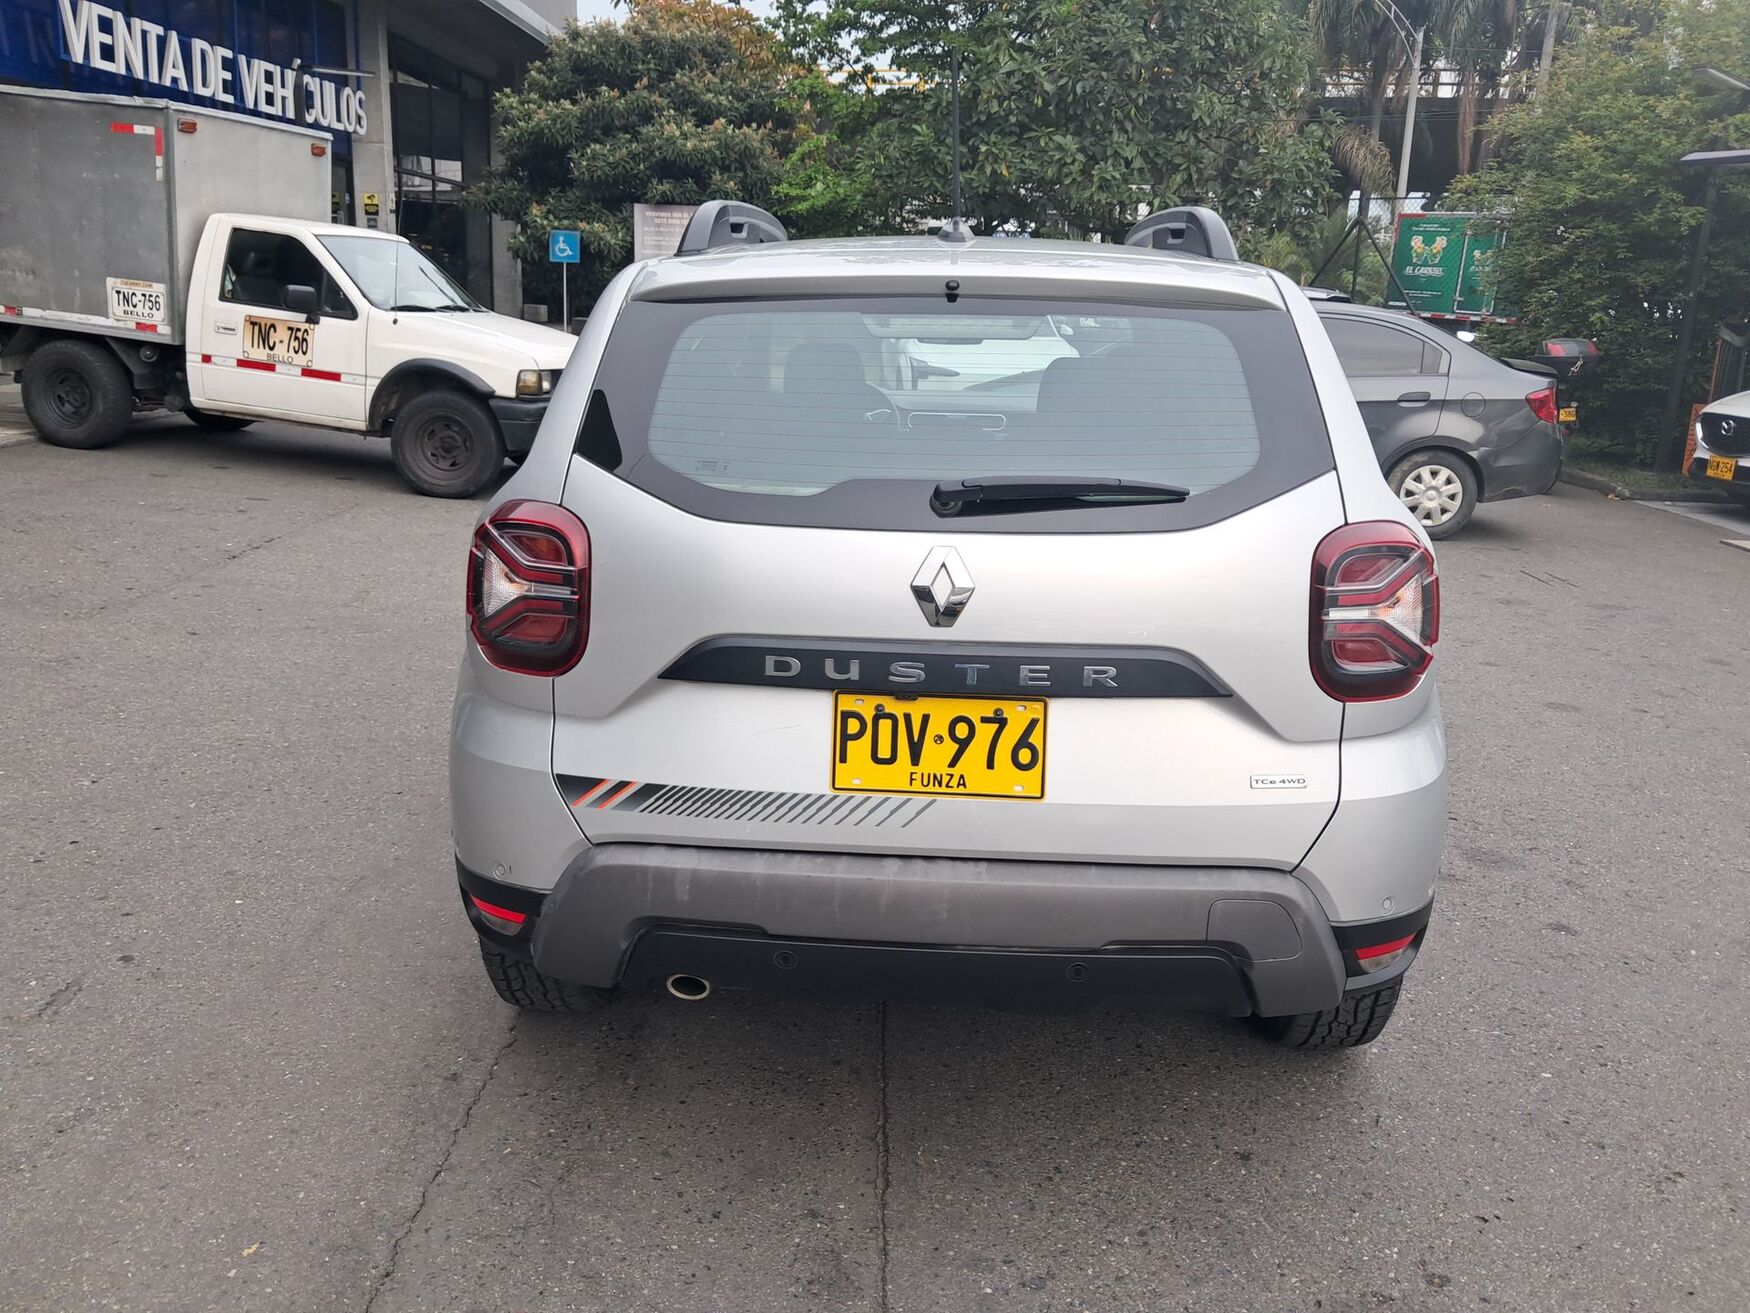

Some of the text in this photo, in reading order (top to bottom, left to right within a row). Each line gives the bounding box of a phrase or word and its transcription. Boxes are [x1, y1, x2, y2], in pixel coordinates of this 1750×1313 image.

[59, 0, 188, 92] VENTA
[192, 38, 236, 104] DE
[115, 289, 161, 312] TNC-756
[123, 309, 154, 319] BELLO
[266, 352, 294, 364] BELLO
[764, 655, 1119, 688] DUSTER
[909, 771, 968, 790] FUNZA
